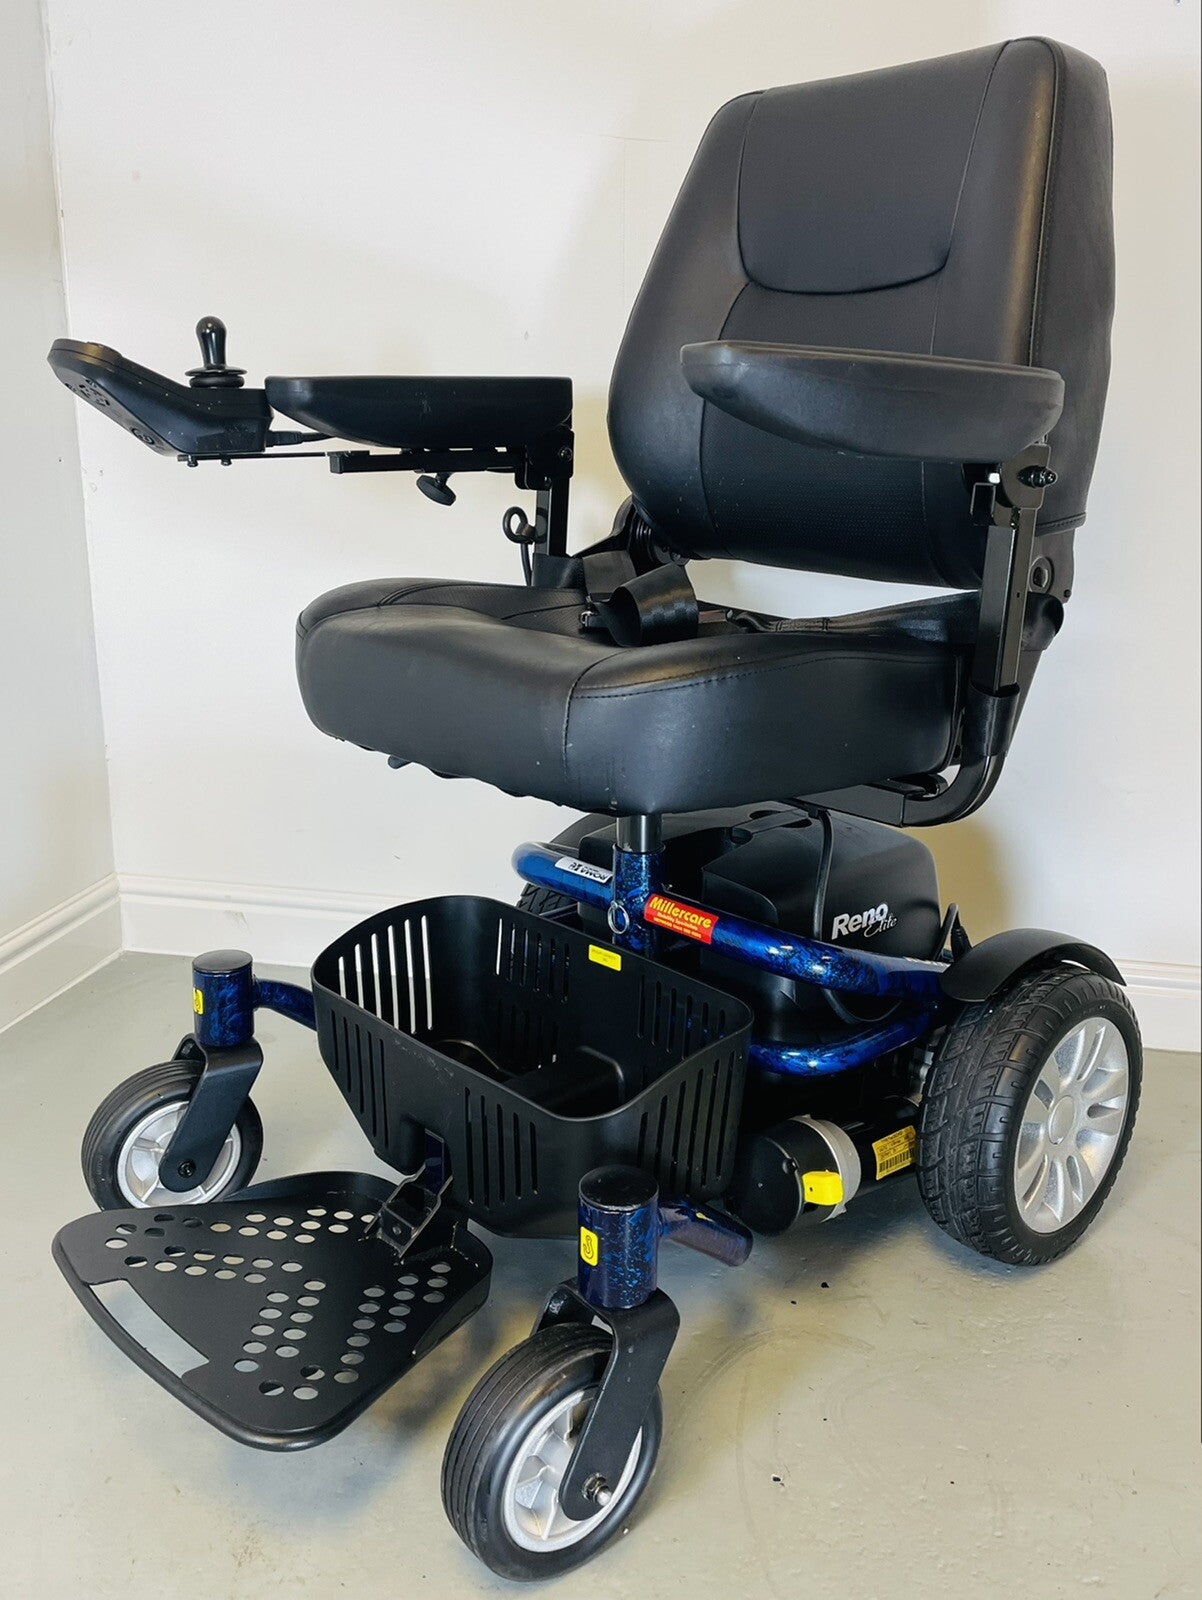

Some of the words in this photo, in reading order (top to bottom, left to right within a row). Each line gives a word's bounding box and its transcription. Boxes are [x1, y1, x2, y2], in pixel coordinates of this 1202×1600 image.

[650, 897, 712, 928] Millercare
[831, 903, 889, 940] Reno
[863, 913, 897, 938] Elite
